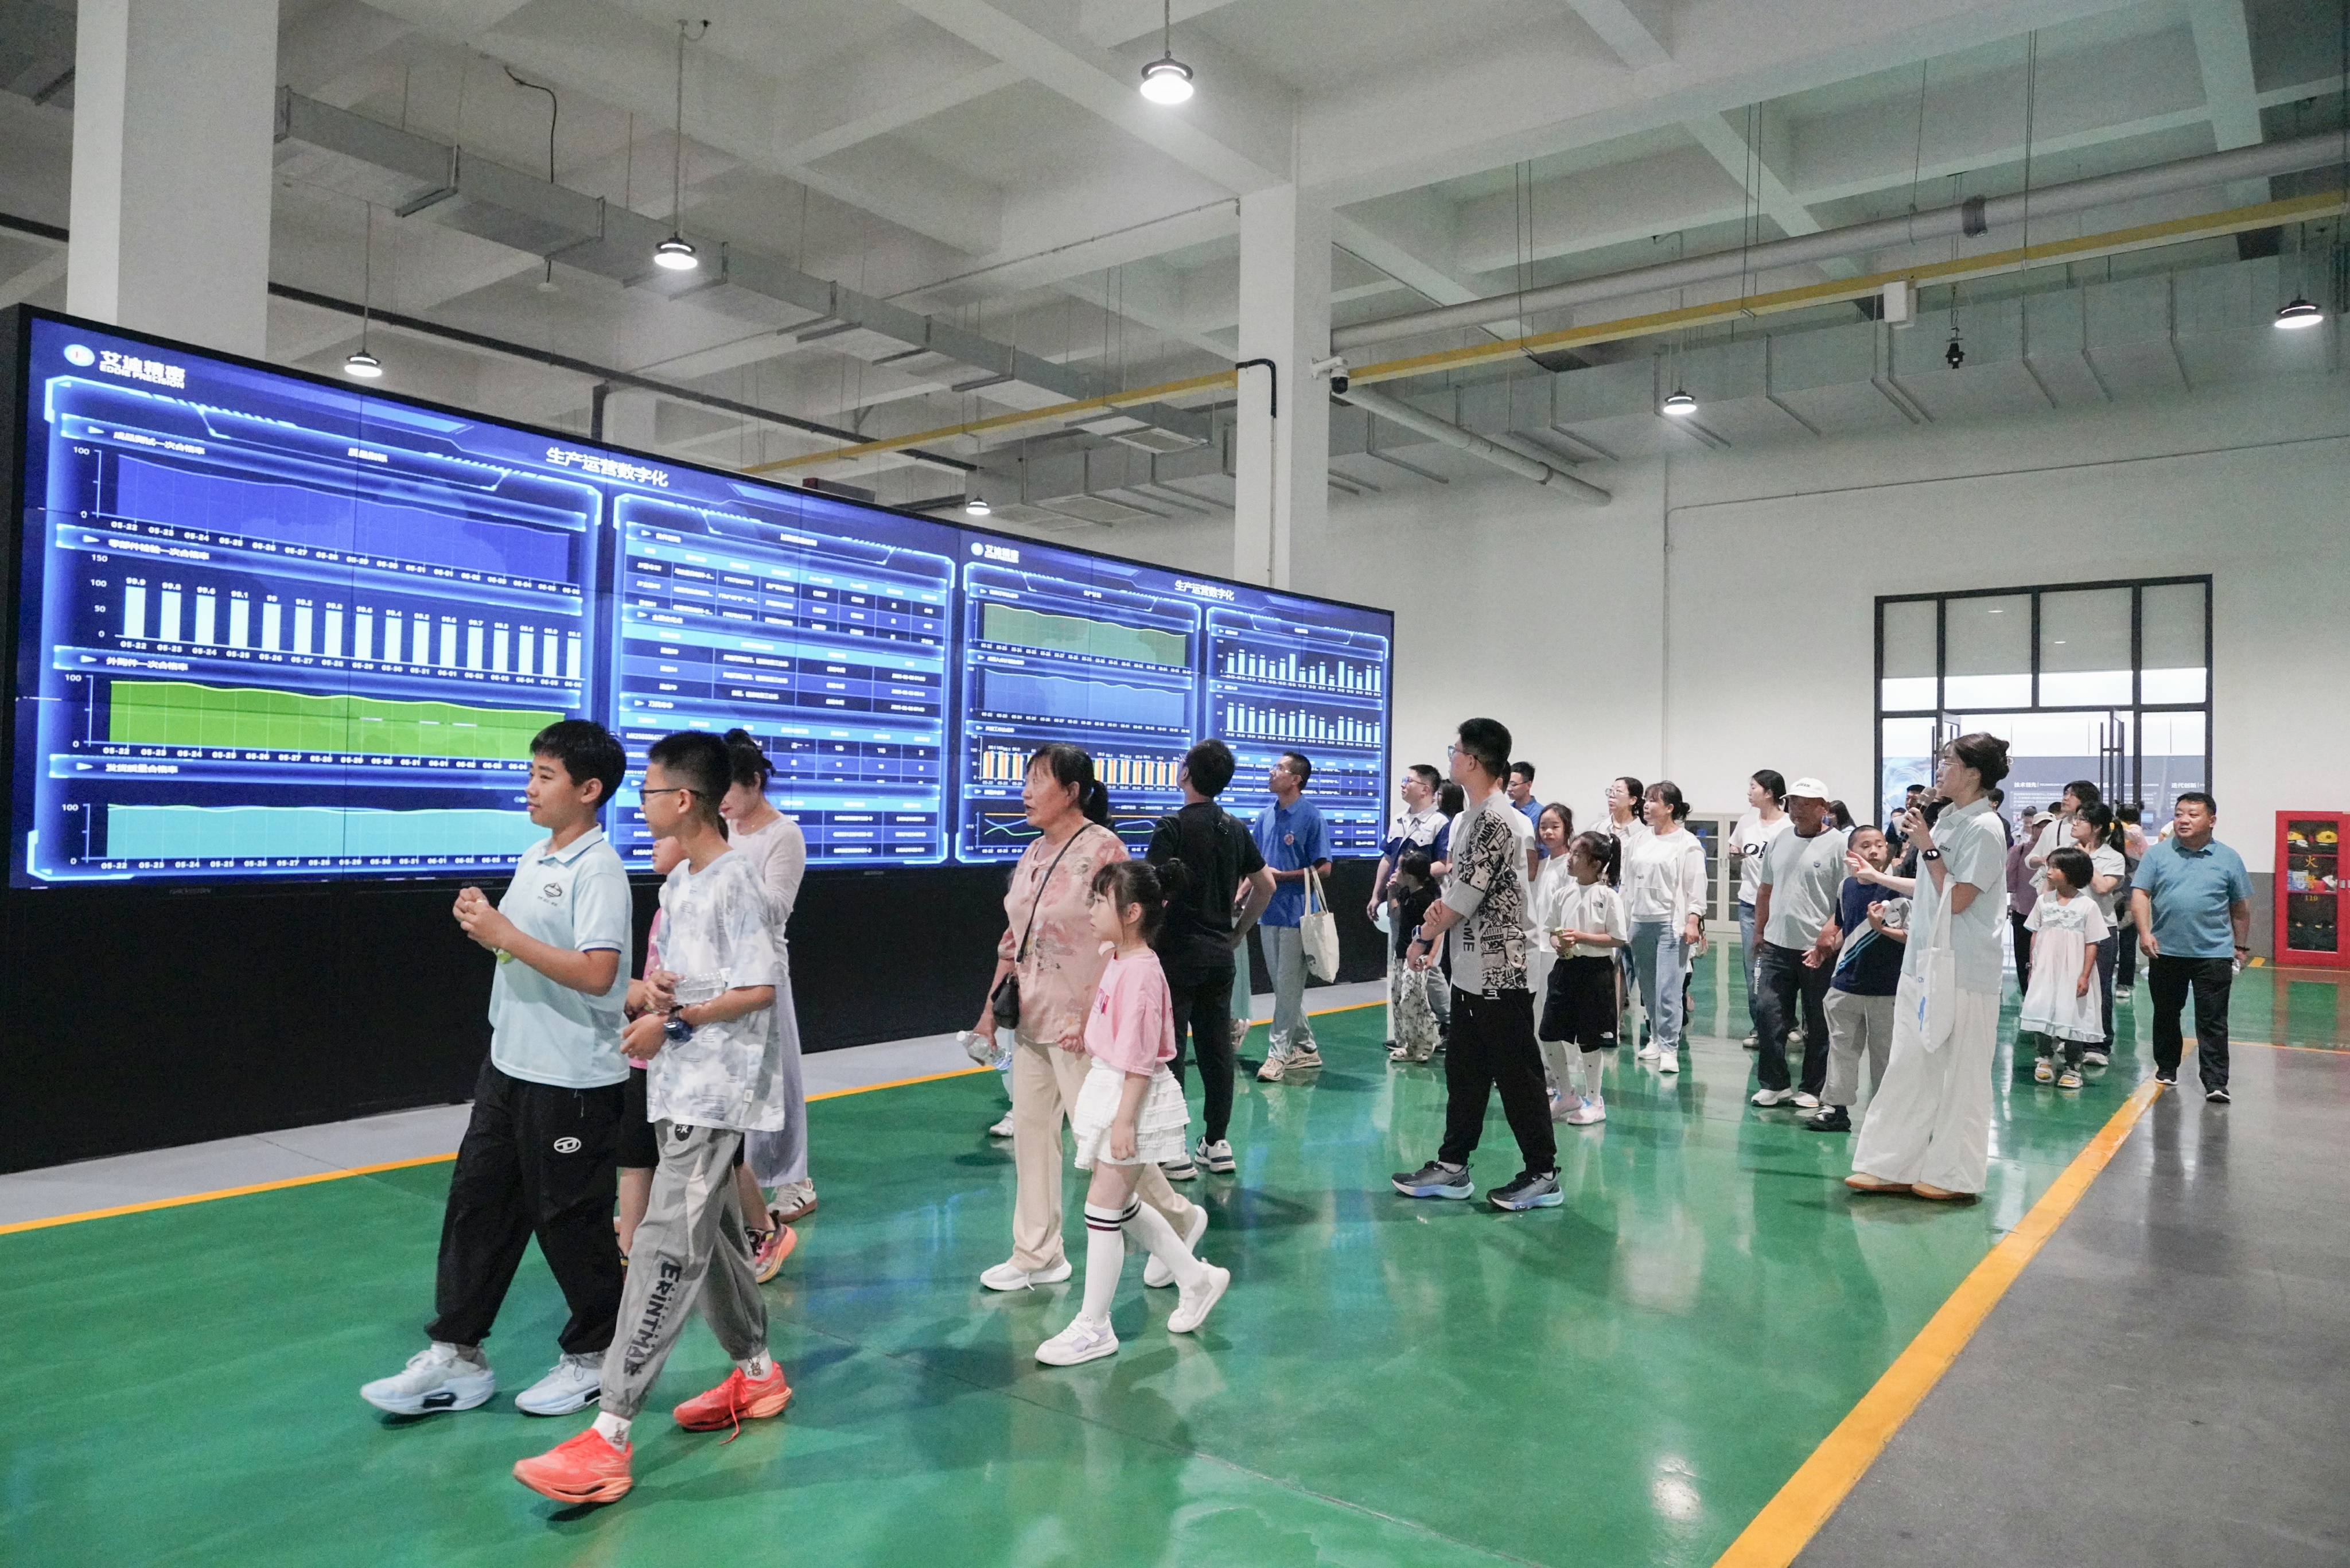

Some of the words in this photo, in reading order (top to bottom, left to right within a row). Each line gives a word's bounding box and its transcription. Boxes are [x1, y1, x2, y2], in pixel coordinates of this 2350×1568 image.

[100, 351, 185, 381] 艾迪精密
[132, 371, 185, 389] PRECISION
[544, 447, 668, 488] 生产运营数字化
[111, 521, 138, 531] 05-22
[184, 532, 209, 542] 05-24
[1174, 579, 1234, 601] 生产运营数字化
[120, 641, 146, 649] 05-22
[192, 647, 216, 655] 05-24
